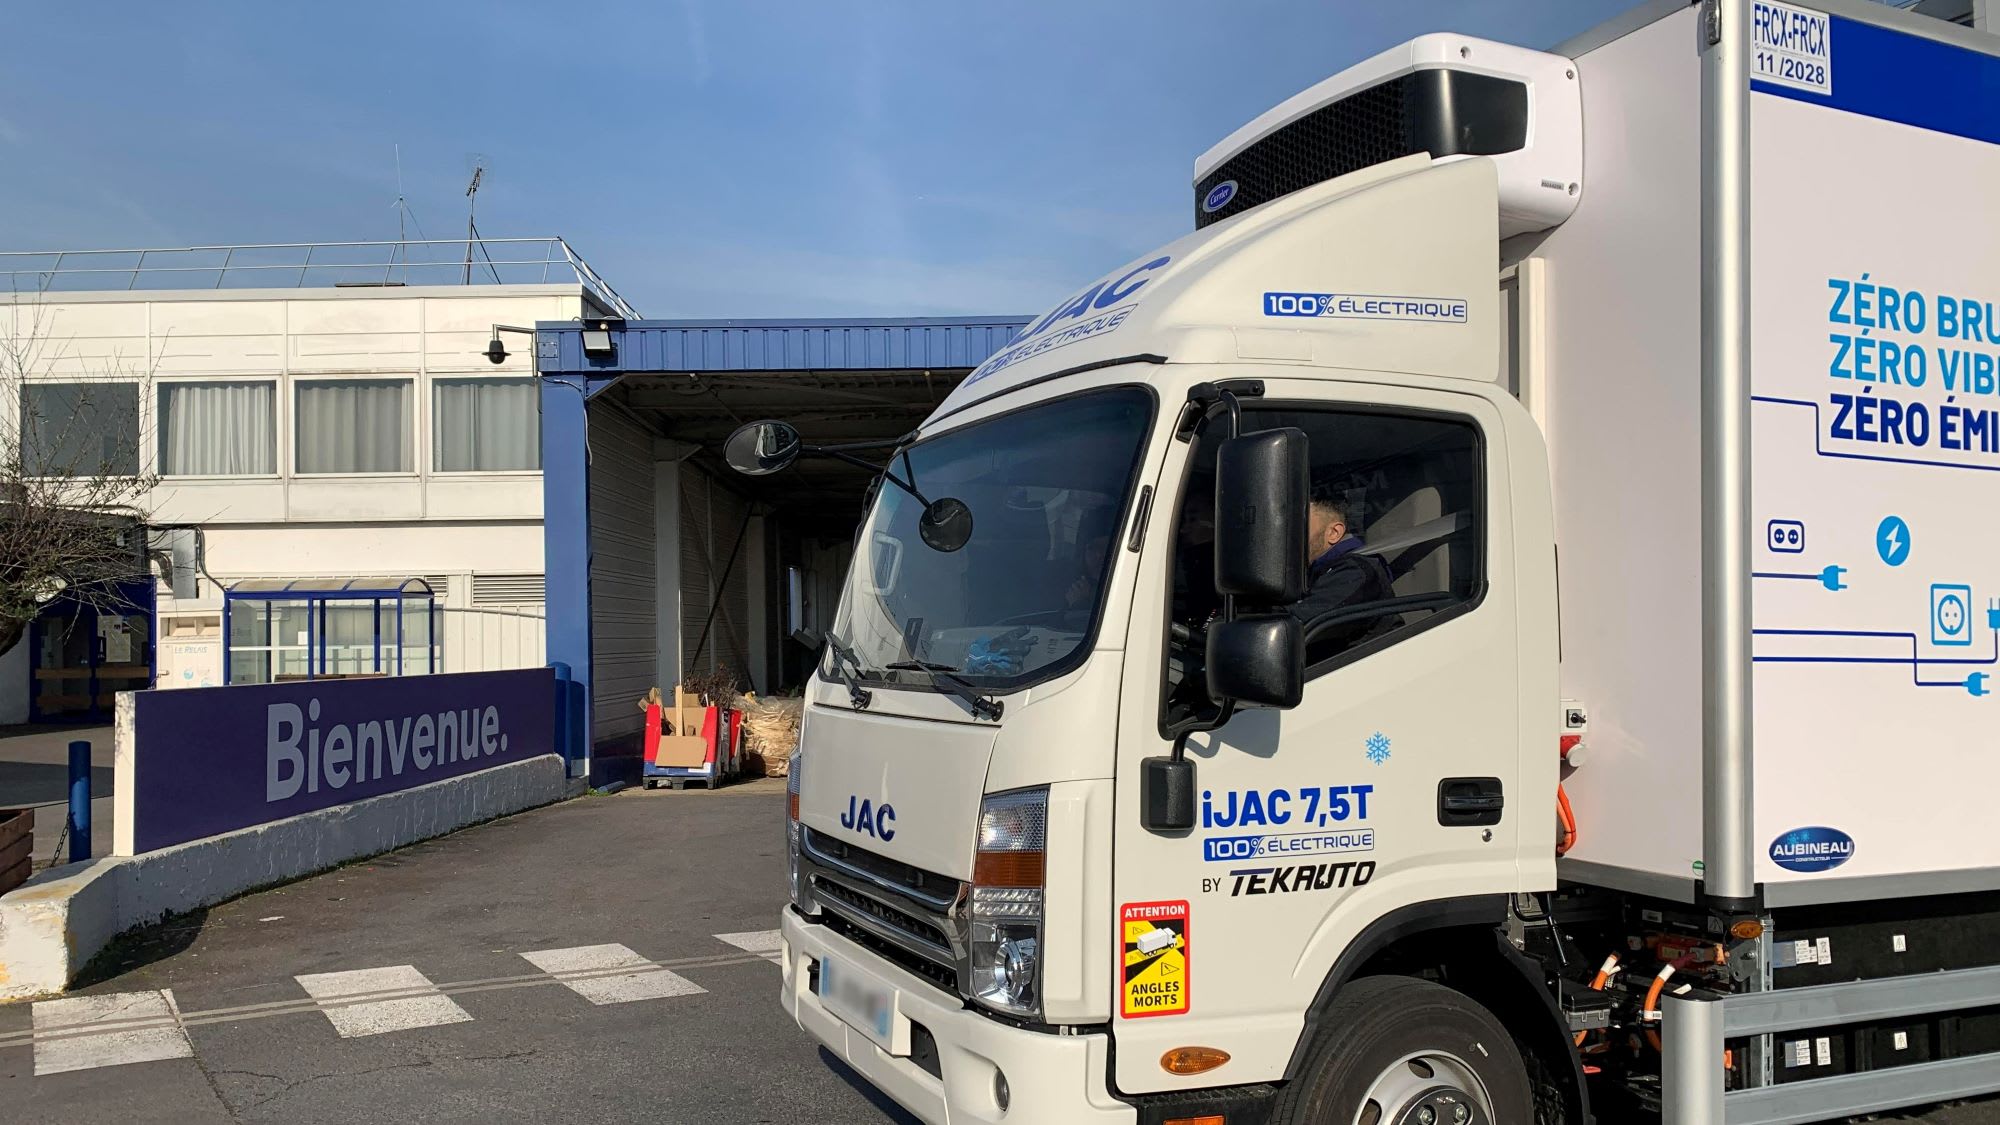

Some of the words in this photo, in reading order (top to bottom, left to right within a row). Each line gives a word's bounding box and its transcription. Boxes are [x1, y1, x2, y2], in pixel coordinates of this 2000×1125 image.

[1754, 3, 1826, 57] FRCX-FRCX
[1269, 294, 1335, 315] 100%
[1338, 297, 1465, 317] ÉLECTRIQUE
[1828, 273, 1926, 334] ZÉRO
[1829, 328, 1927, 388] ZÉRO
[1937, 348, 2000, 397] VIB
[1830, 385, 1929, 447] ZÉRO
[267, 698, 508, 802] Bienvenue.
[840, 795, 896, 842] JAC
[1202, 789, 1291, 828] iJAC
[1300, 784, 1373, 827] 7,5T
[1208, 837, 1265, 858] 100%
[1268, 833, 1372, 853] ÉLECTRIQUE
[1773, 841, 1850, 856] AUBINEAU
[1202, 877, 1221, 893] BY
[1229, 860, 1376, 897] TEKAUTO
[1125, 904, 1185, 919] ATTENTION
[1131, 980, 1180, 996] ANGLES
[1134, 993, 1178, 1008] MORTS
